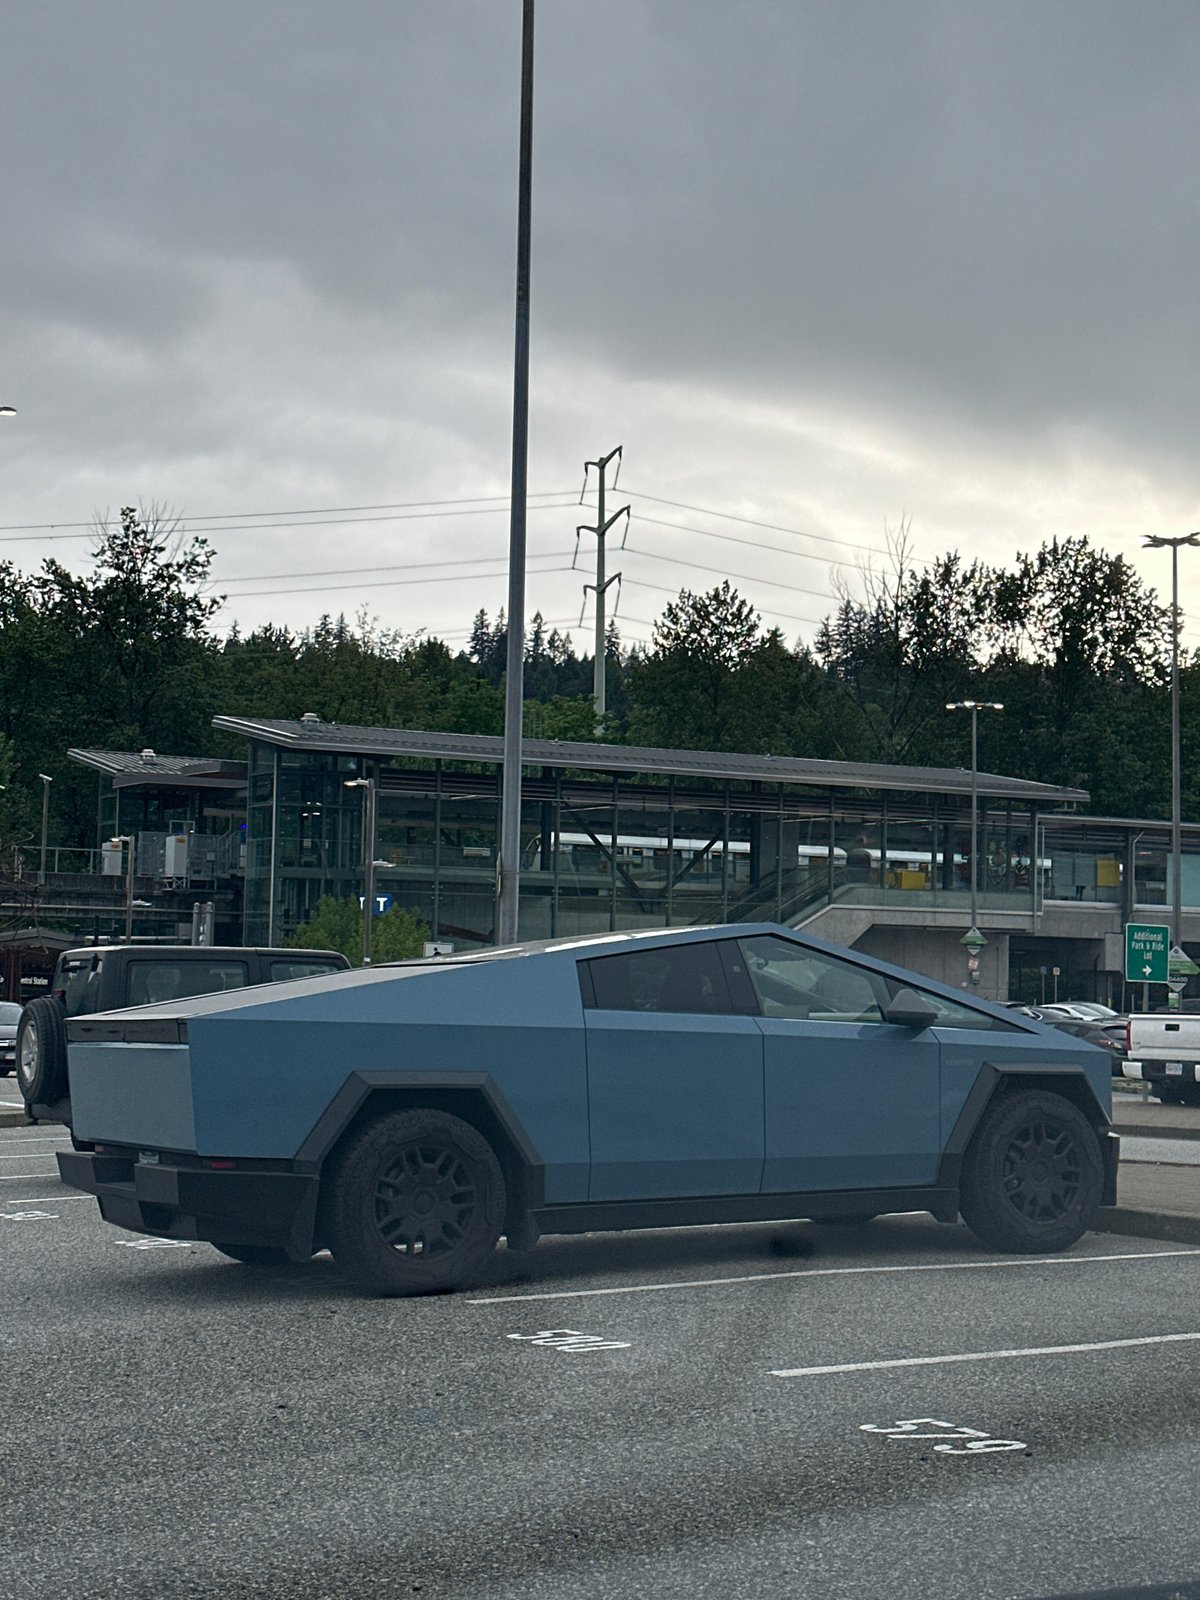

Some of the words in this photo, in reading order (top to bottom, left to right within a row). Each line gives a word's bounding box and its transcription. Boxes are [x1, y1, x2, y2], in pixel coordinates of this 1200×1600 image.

[376, 897, 388, 912] T
[1133, 931, 1163, 942] Additional
[1131, 941, 1145, 950] Park
[1146, 941, 1151, 951] &
[1151, 941, 1165, 951] Ride
[1143, 951, 1153, 960] Lot
[33, 976, 48, 985] Station
[859, 1418, 1027, 1455] 579
